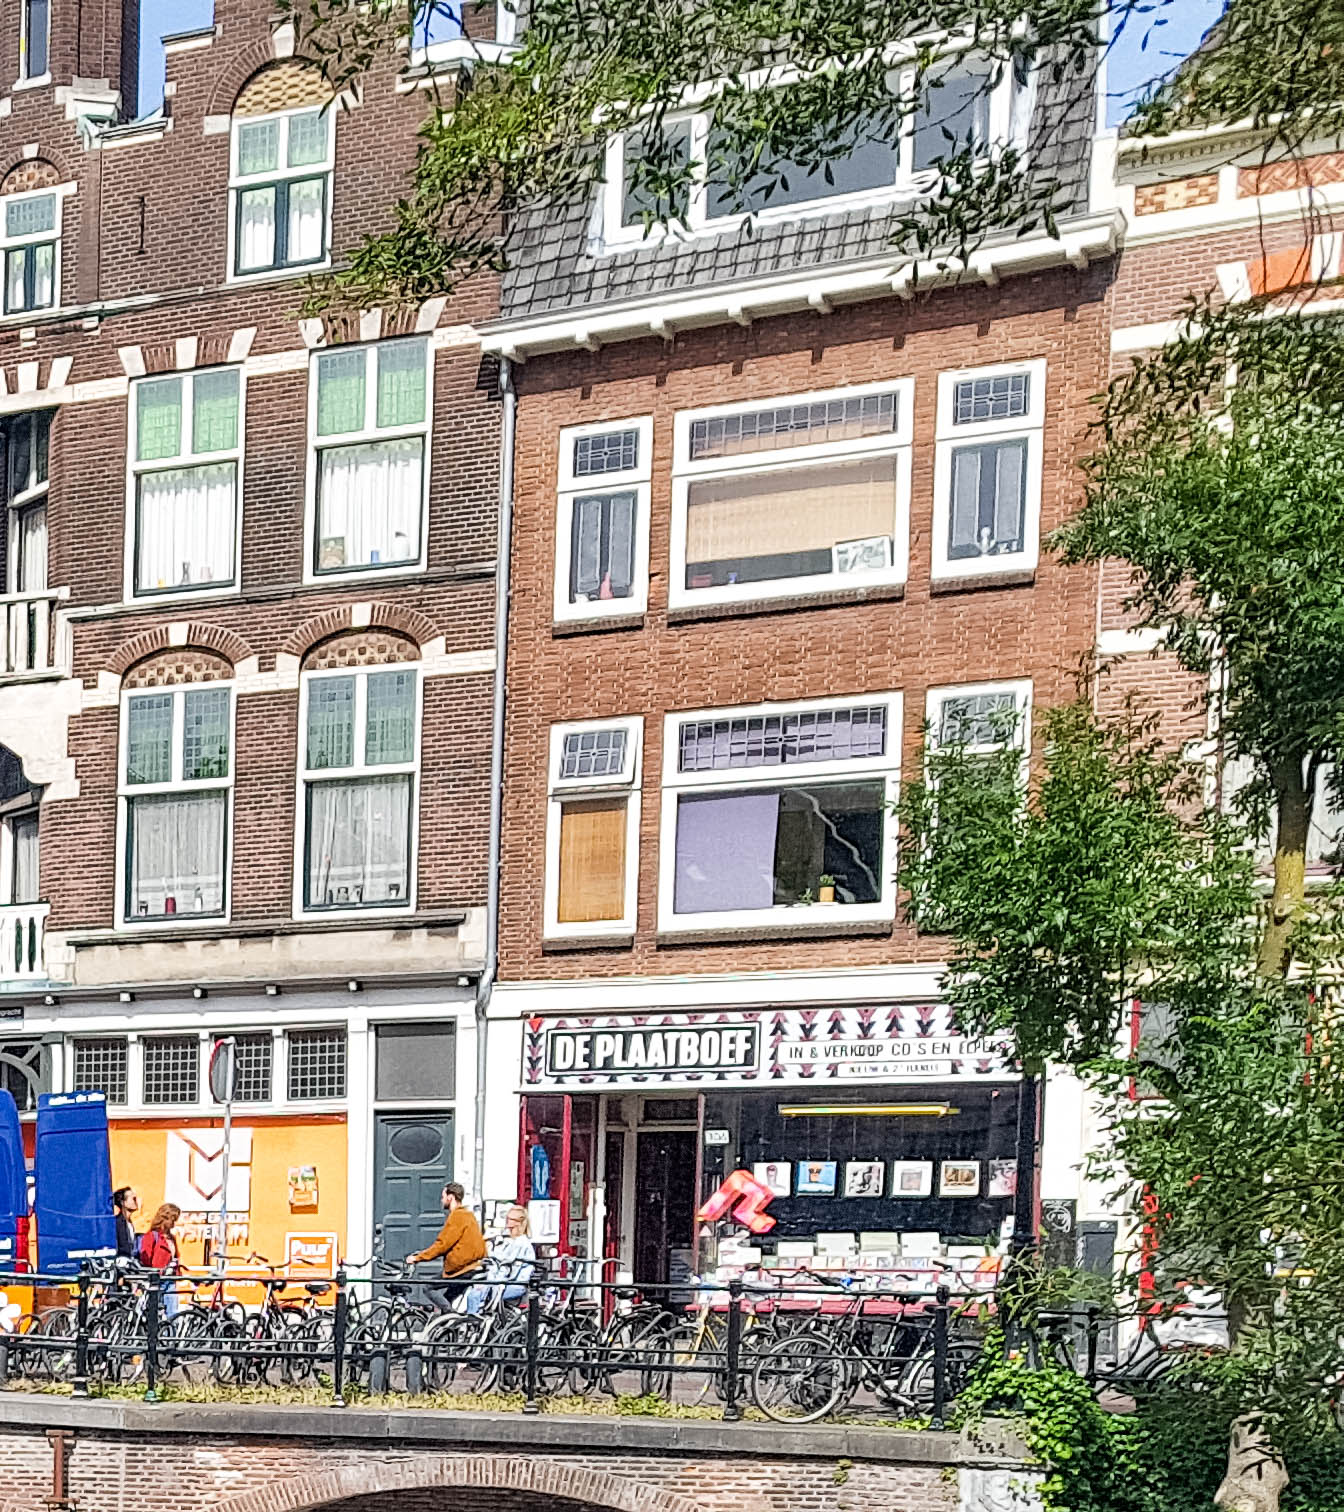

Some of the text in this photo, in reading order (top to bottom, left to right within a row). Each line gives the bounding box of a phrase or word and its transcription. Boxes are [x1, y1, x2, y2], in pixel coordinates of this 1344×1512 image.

[554, 1030, 753, 1070] DE PLAATBOEF
[789, 1046, 804, 1058] IN
[810, 1047, 818, 1058] &
[824, 1044, 884, 1058] VERKOOP
[932, 1042, 951, 1055] EN
